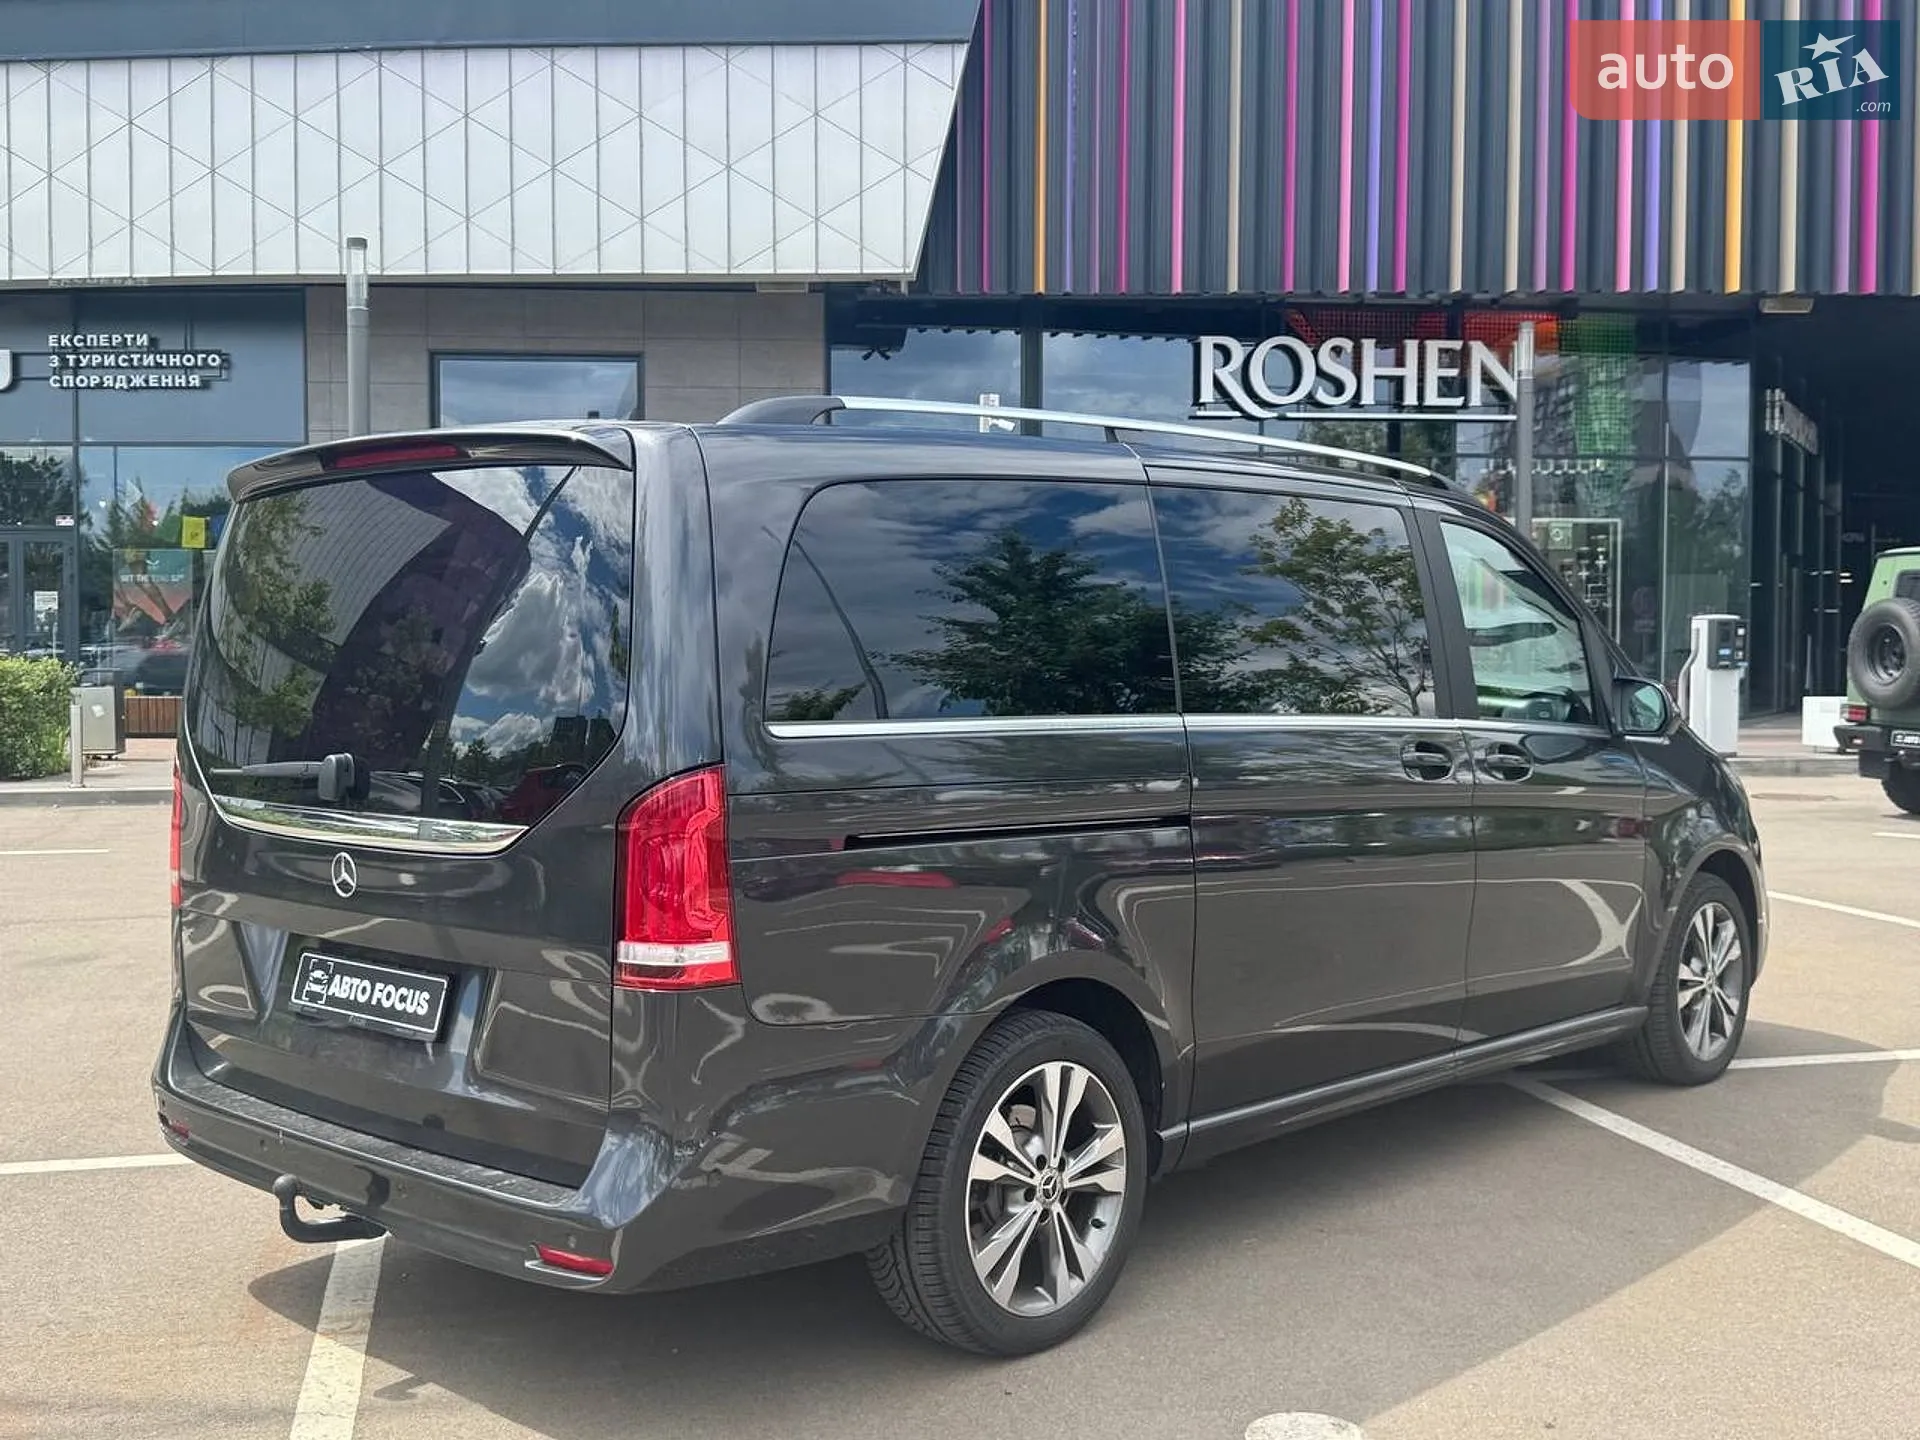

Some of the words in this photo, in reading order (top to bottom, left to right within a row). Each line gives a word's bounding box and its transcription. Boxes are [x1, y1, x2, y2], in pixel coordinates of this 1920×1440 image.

[48, 333, 149, 347] ЕКСПЕРТИ
[48, 354, 61, 368] З
[66, 353, 223, 369] ТУРИСТИЧНОГО
[49, 374, 201, 390] СПОРЯДЖЕННЯ
[1197, 335, 1517, 418] ROSHEN
[328, 974, 371, 1003] АВТО
[371, 983, 431, 1016] FOCUS
